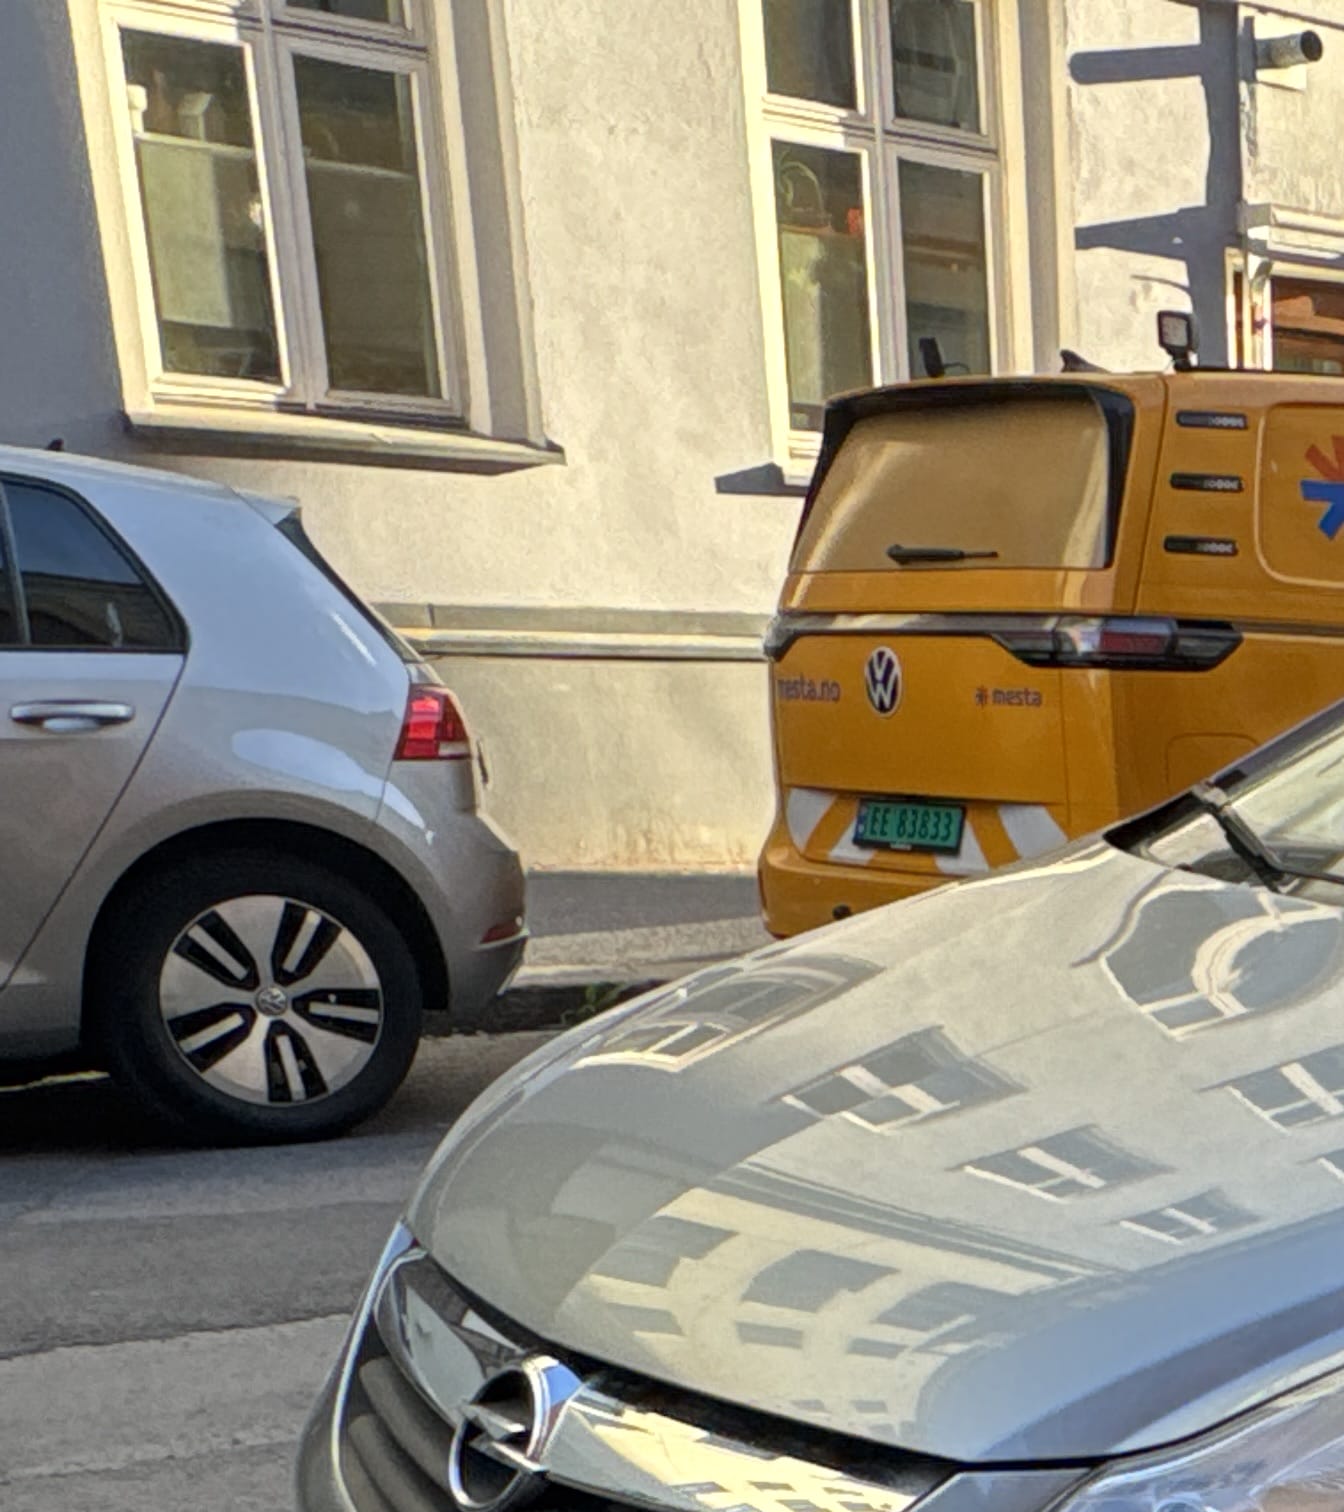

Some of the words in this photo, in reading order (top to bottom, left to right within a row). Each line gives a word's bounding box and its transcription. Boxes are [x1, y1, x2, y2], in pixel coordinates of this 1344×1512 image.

[992, 687, 1043, 708] mesta
[869, 805, 889, 837] EE
[898, 807, 952, 842] 83833
